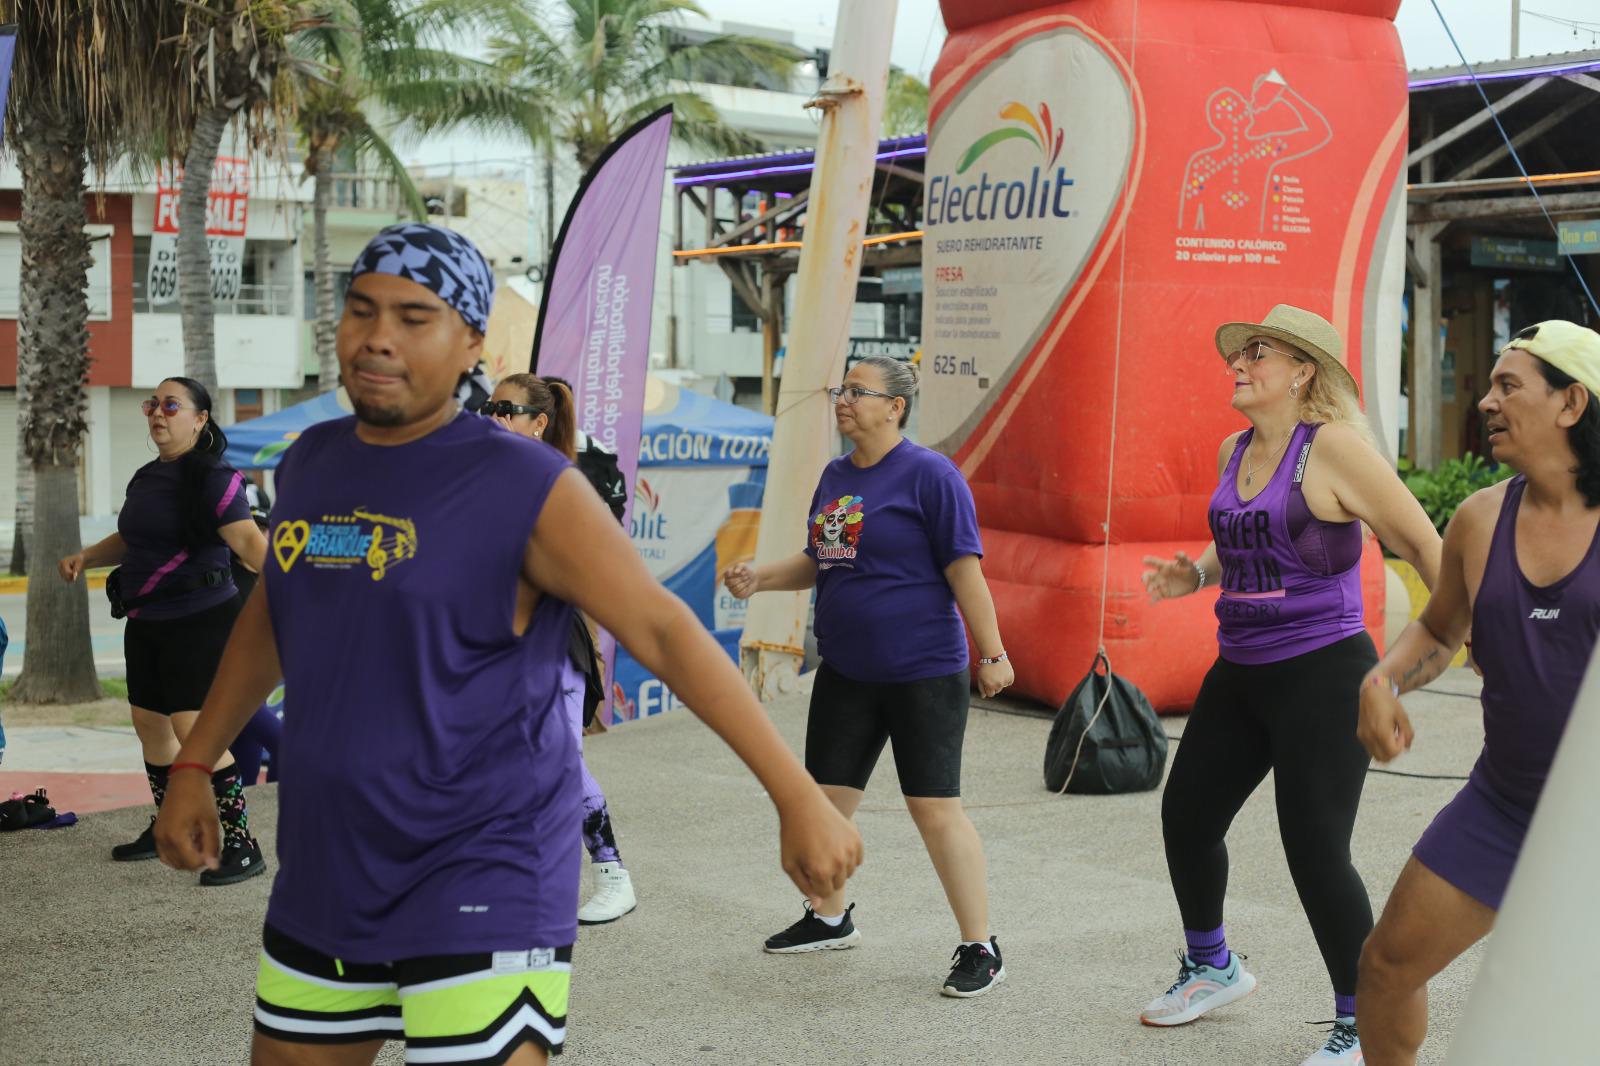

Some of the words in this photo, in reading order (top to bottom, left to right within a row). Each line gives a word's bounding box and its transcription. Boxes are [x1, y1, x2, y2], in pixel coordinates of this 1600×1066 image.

[927, 166, 1074, 226] Electrolit
[206, 196, 245, 231] SALE
[936, 239, 962, 254] SUERO
[964, 236, 1043, 252] REHIDRATANTE
[1176, 237, 1235, 249] CONTENIDO
[1176, 250, 1190, 261] 20
[151, 265, 177, 298] 669
[935, 266, 964, 282] FRESA
[934, 355, 957, 375] 625
[960, 356, 978, 376] mL
[816, 541, 857, 559] Zumba
[1253, 557, 1284, 592] IN
[1528, 608, 1560, 619] RUN
